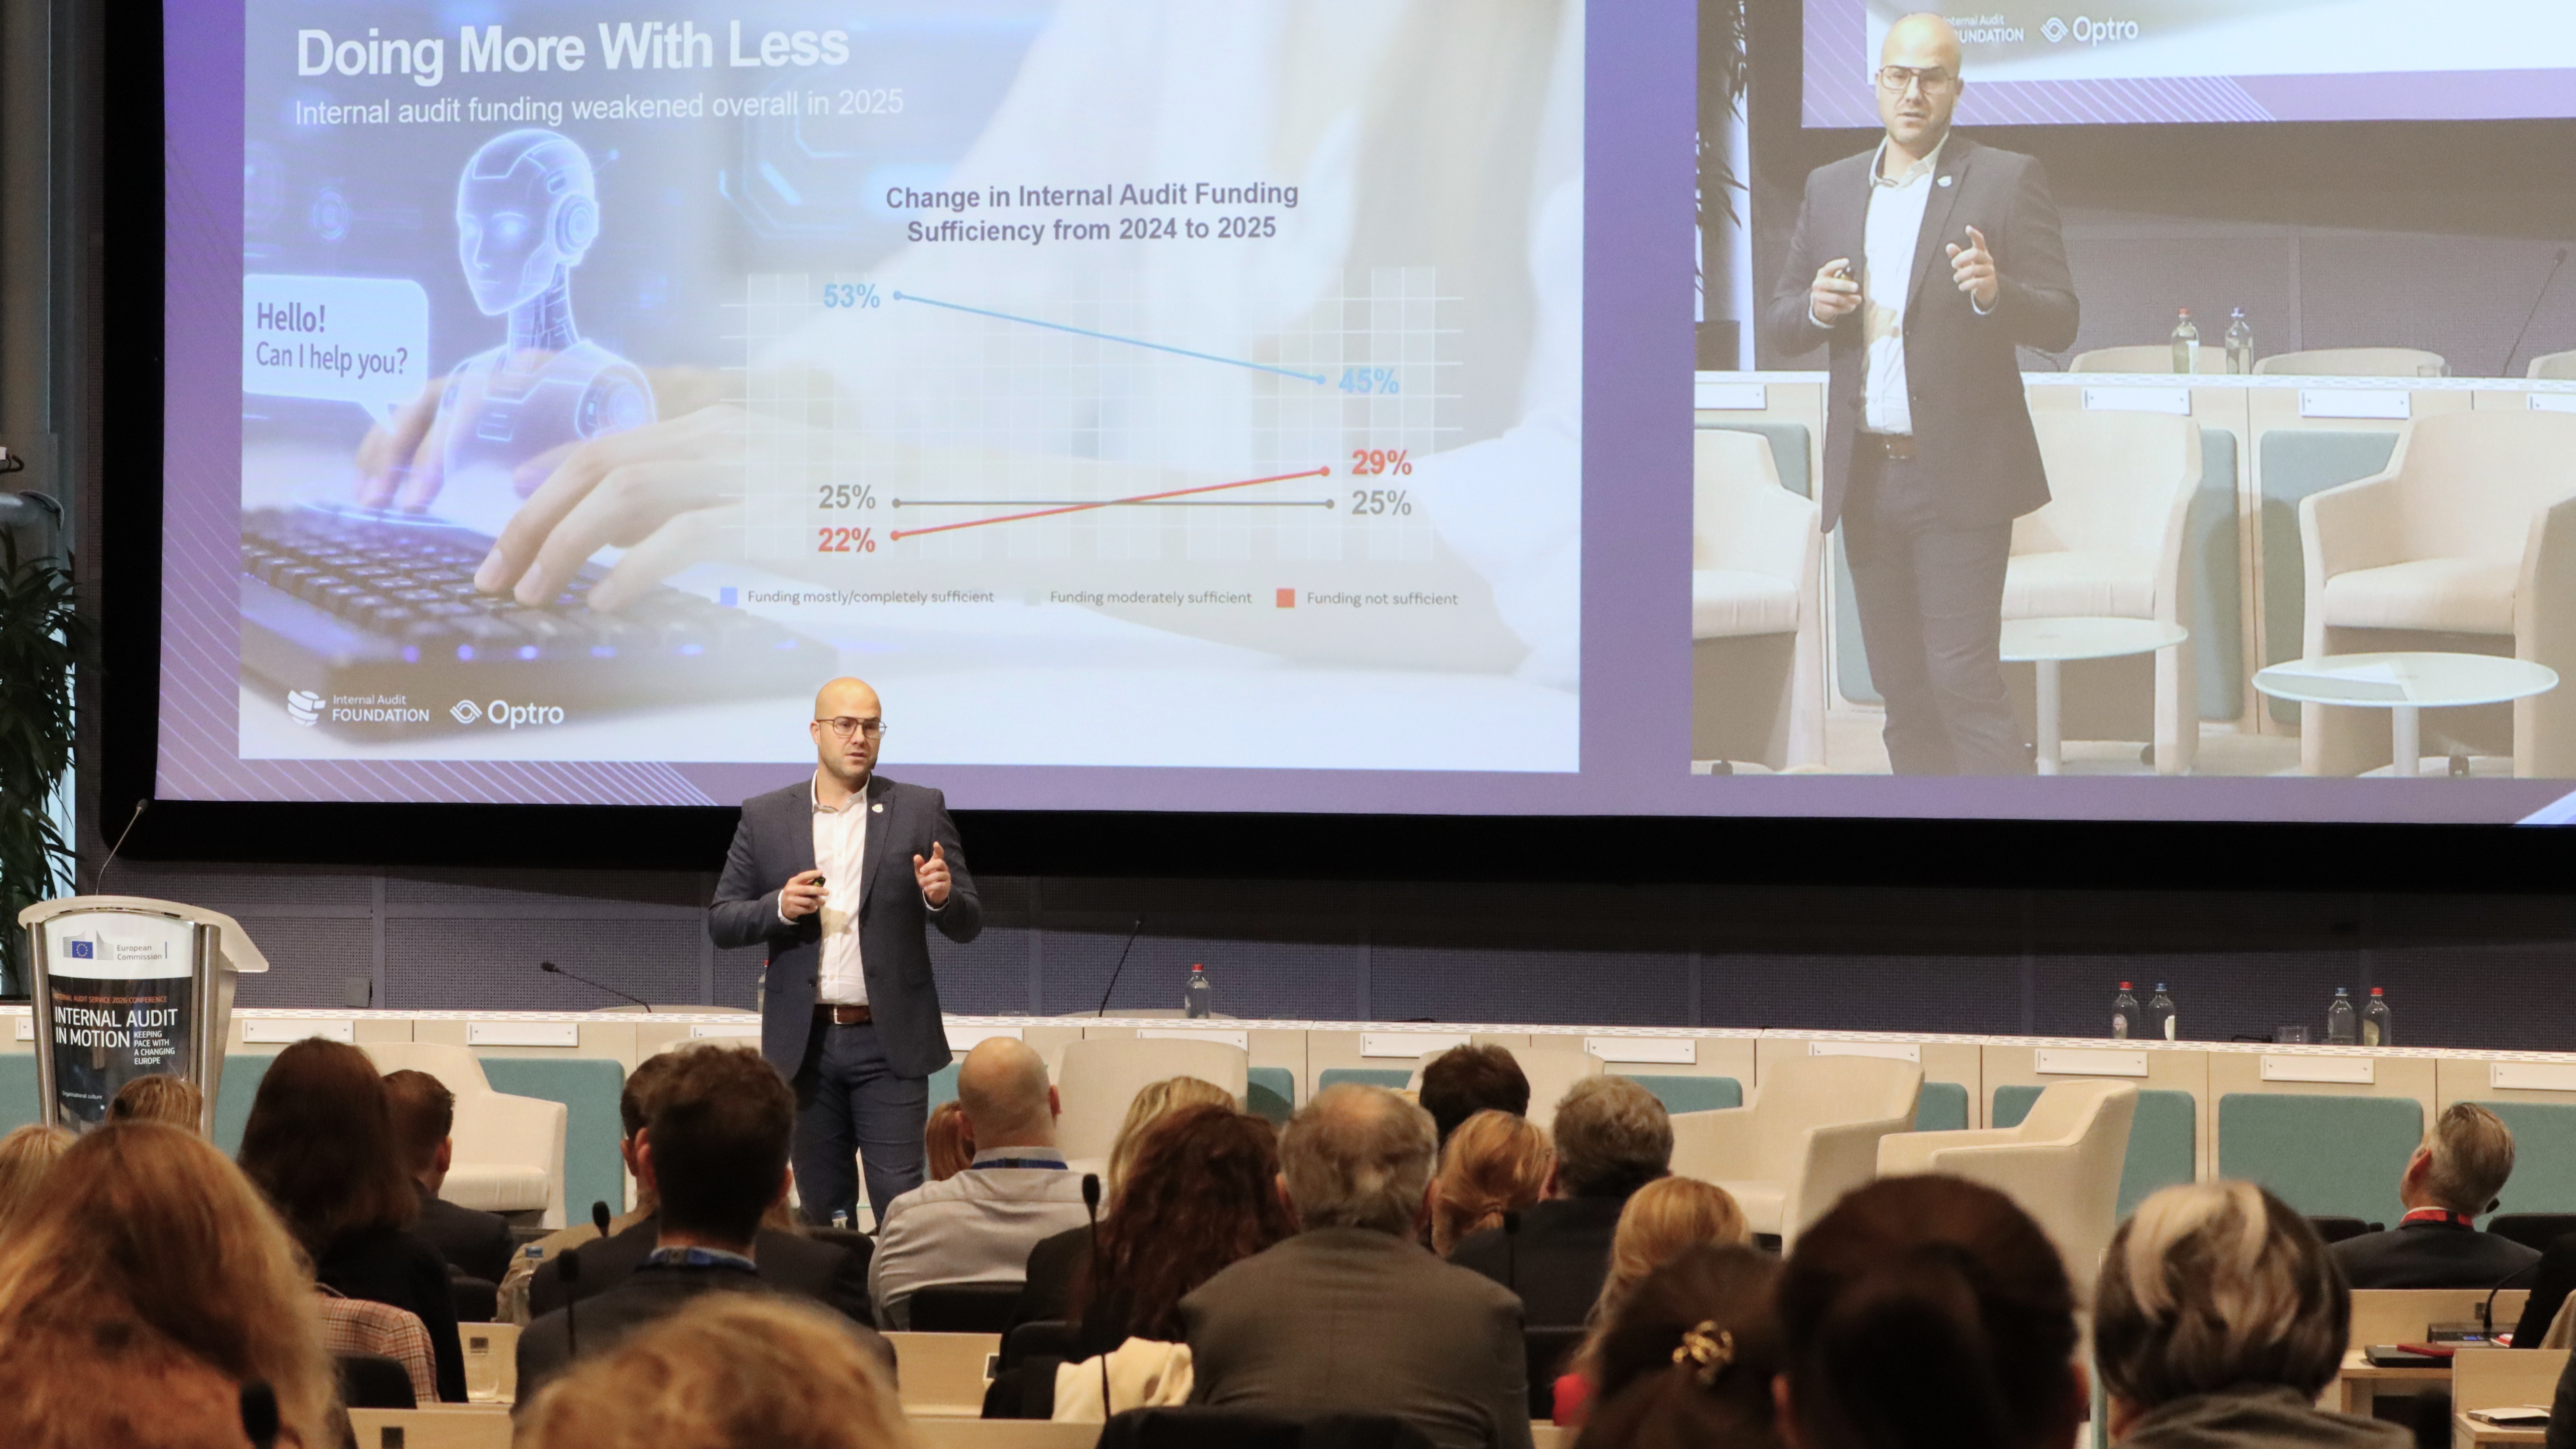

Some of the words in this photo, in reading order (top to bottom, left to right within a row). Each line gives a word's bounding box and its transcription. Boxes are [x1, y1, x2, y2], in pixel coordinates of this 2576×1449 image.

[1979, 13, 2005, 25] Audit
[2072, 16, 2139, 46] Optro
[297, 28, 443, 87] Doing
[460, 25, 585, 73] More
[599, 21, 712, 70] With
[730, 19, 849, 68] Less
[295, 99, 389, 125] Internal
[398, 97, 461, 123] audit
[468, 95, 562, 128] funding
[571, 94, 703, 121] weakened
[713, 91, 799, 118] overall
[808, 90, 829, 116] in
[838, 88, 904, 115] 2025
[886, 186, 980, 213] Change
[990, 186, 1010, 207] in
[1019, 184, 1112, 207] Internal
[1120, 183, 1188, 205] Audit
[1196, 182, 1298, 208] Funding
[908, 220, 1045, 245] Sufficiency
[1053, 218, 1110, 240] from
[1119, 217, 1177, 240] 2024
[1185, 218, 1209, 238] to
[1218, 216, 1276, 238] 2025
[823, 283, 880, 309] 53%
[258, 302, 325, 332] Hello!
[256, 341, 292, 367] Can
[300, 344, 303, 368] I
[310, 343, 352, 378] help
[358, 347, 408, 380] you?
[1339, 368, 1399, 395] 45%
[1352, 449, 1412, 476] 29%
[819, 484, 876, 511] 25%
[1352, 490, 1412, 516] 25%
[818, 527, 876, 554] 22%
[748, 590, 800, 605] Funding
[804, 590, 928, 605] mostly/completely
[931, 590, 995, 603] sufficient
[1051, 591, 1104, 606] Funding
[1107, 591, 1184, 606] moderately
[1188, 591, 1252, 604] sufficient
[1307, 592, 1361, 607] Funding
[1365, 593, 1388, 604] not
[1392, 592, 1458, 605] sufficient
[333, 694, 375, 705] Internal
[377, 694, 407, 705] Audit
[332, 709, 429, 722] FOUNDATION
[487, 699, 564, 730] Optro
[55, 1006, 121, 1027] INTERNAL
[126, 1009, 178, 1027] AUDIT
[56, 1027, 67, 1044] IN
[70, 1029, 130, 1048] MOTION
[141, 1047, 175, 1056] CHANGING
